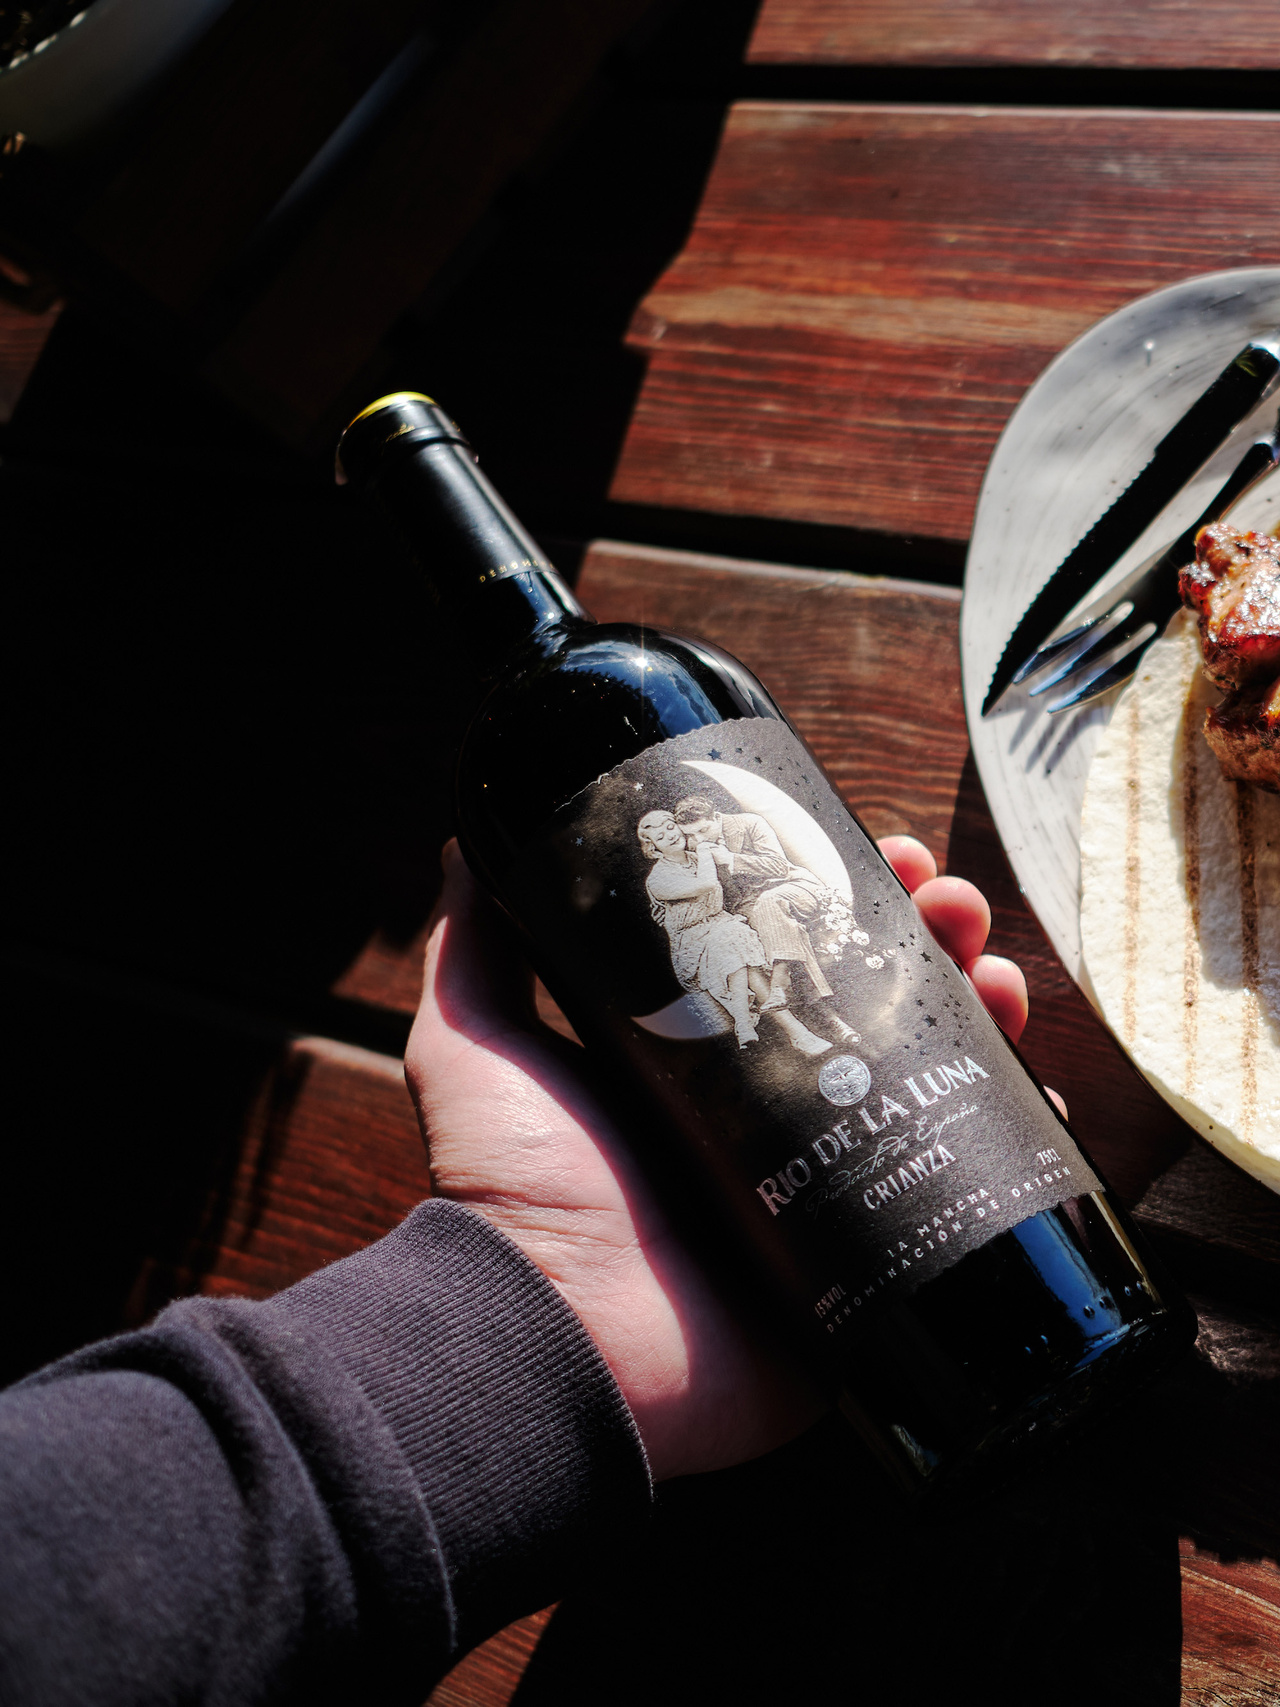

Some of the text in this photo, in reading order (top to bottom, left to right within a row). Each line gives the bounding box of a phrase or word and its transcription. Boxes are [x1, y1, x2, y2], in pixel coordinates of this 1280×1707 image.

[756, 1056, 990, 1216] RIO DE LA LUNA
[915, 1103, 979, 1149] España
[863, 1144, 956, 1211] CRIANZA
[826, 1166, 1071, 1333] DENOMINACIÓN DE ORIGEN
[888, 1188, 989, 1258] LA MANCHA
